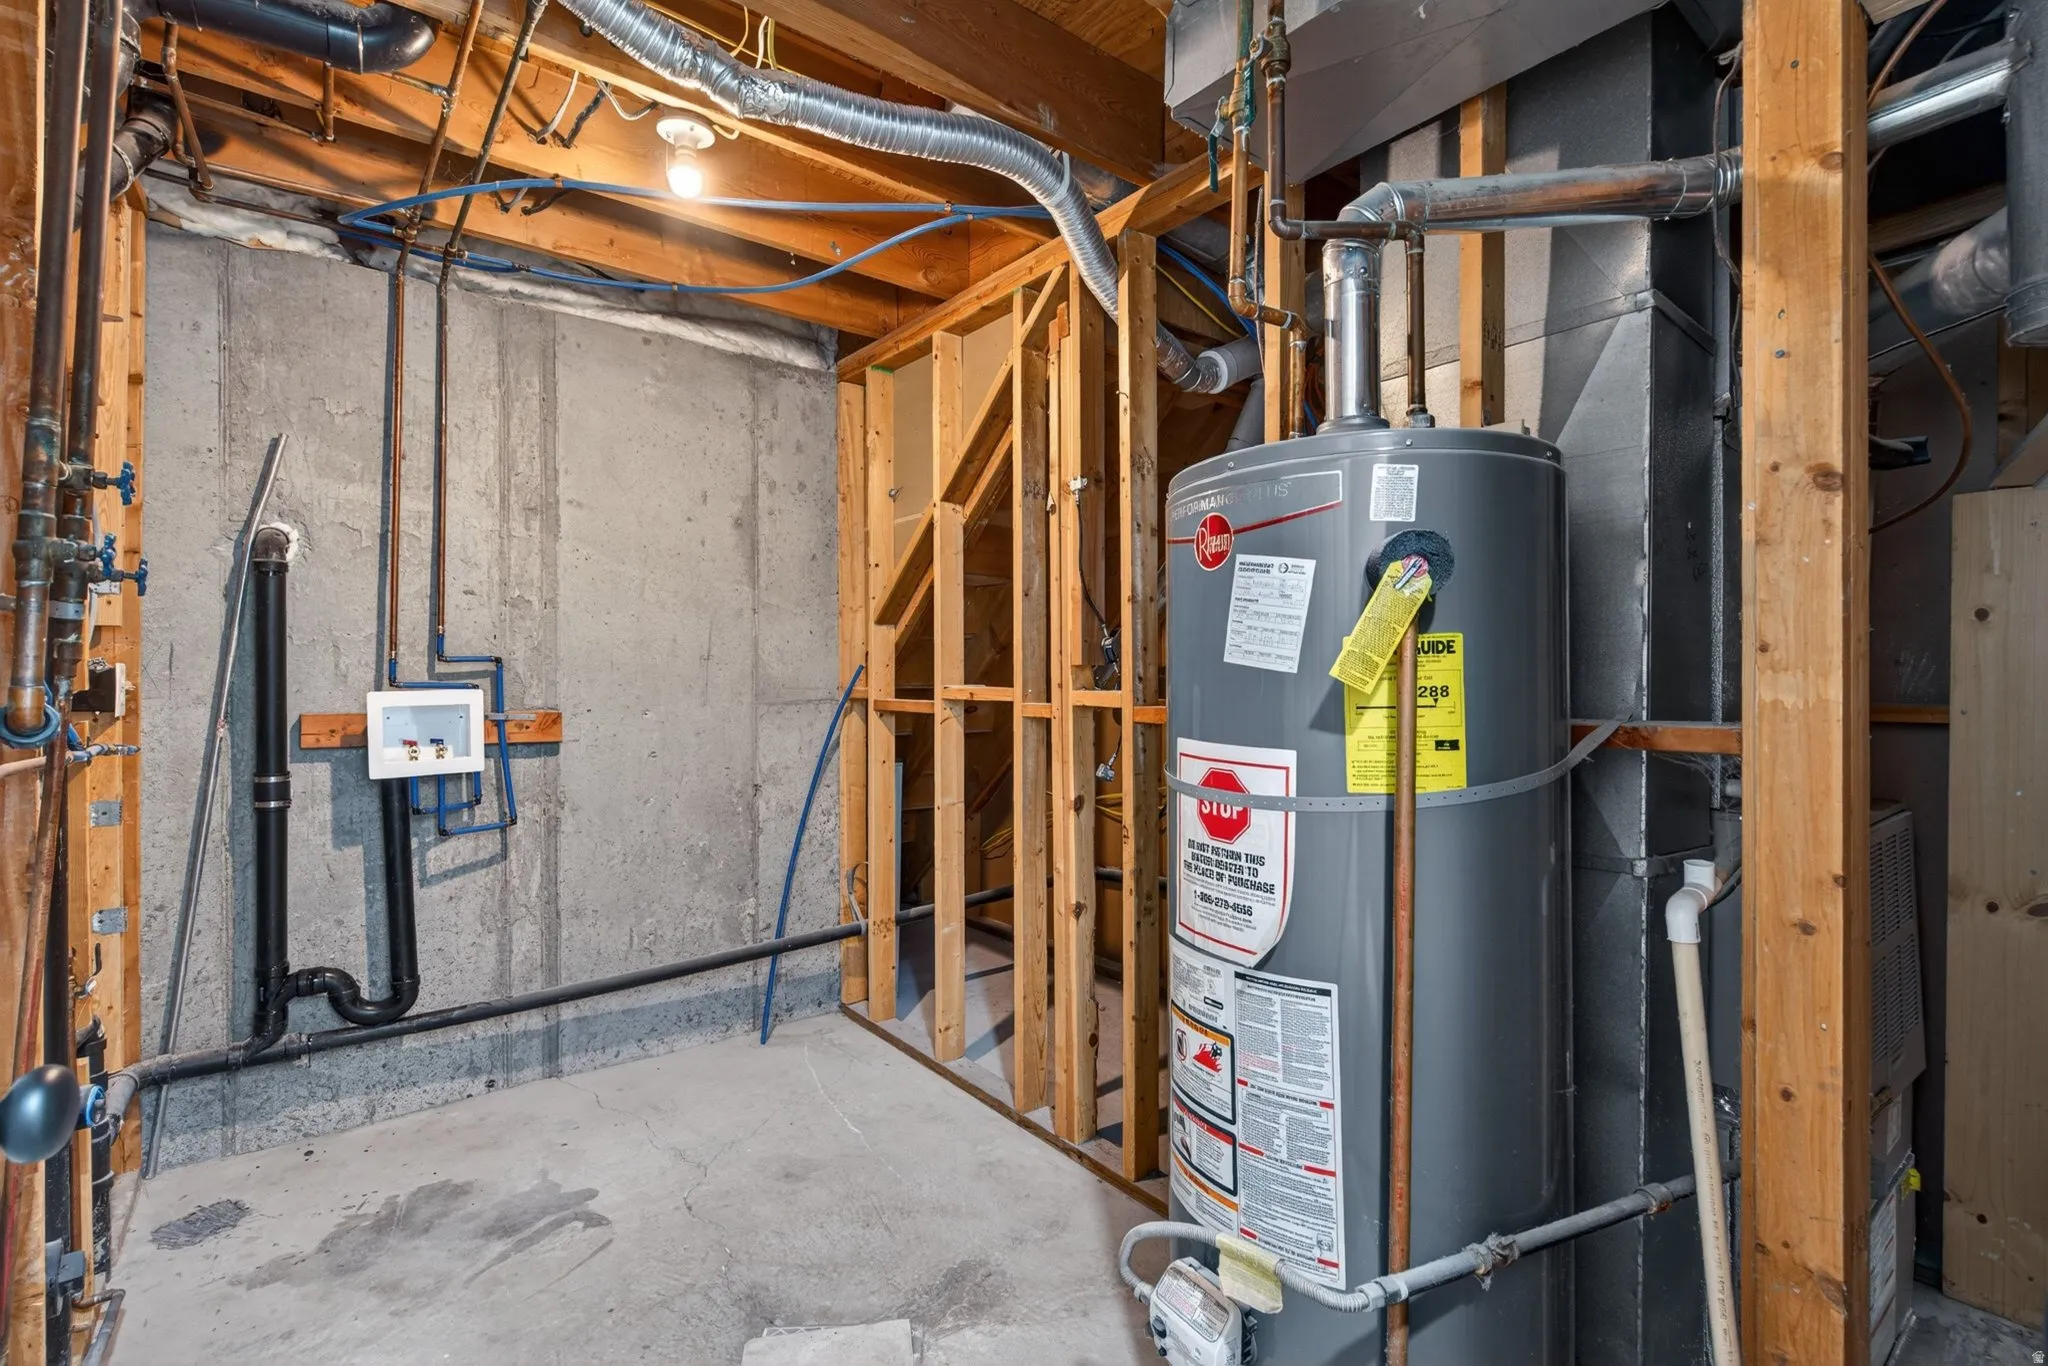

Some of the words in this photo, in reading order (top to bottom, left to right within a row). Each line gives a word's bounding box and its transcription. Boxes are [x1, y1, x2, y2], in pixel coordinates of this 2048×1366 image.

[1172, 492, 1243, 519] PERFORMANC
[1244, 853, 1266, 866] THIS
[1247, 866, 1259, 878] TO
[1227, 874, 1276, 895] PURCHASE
